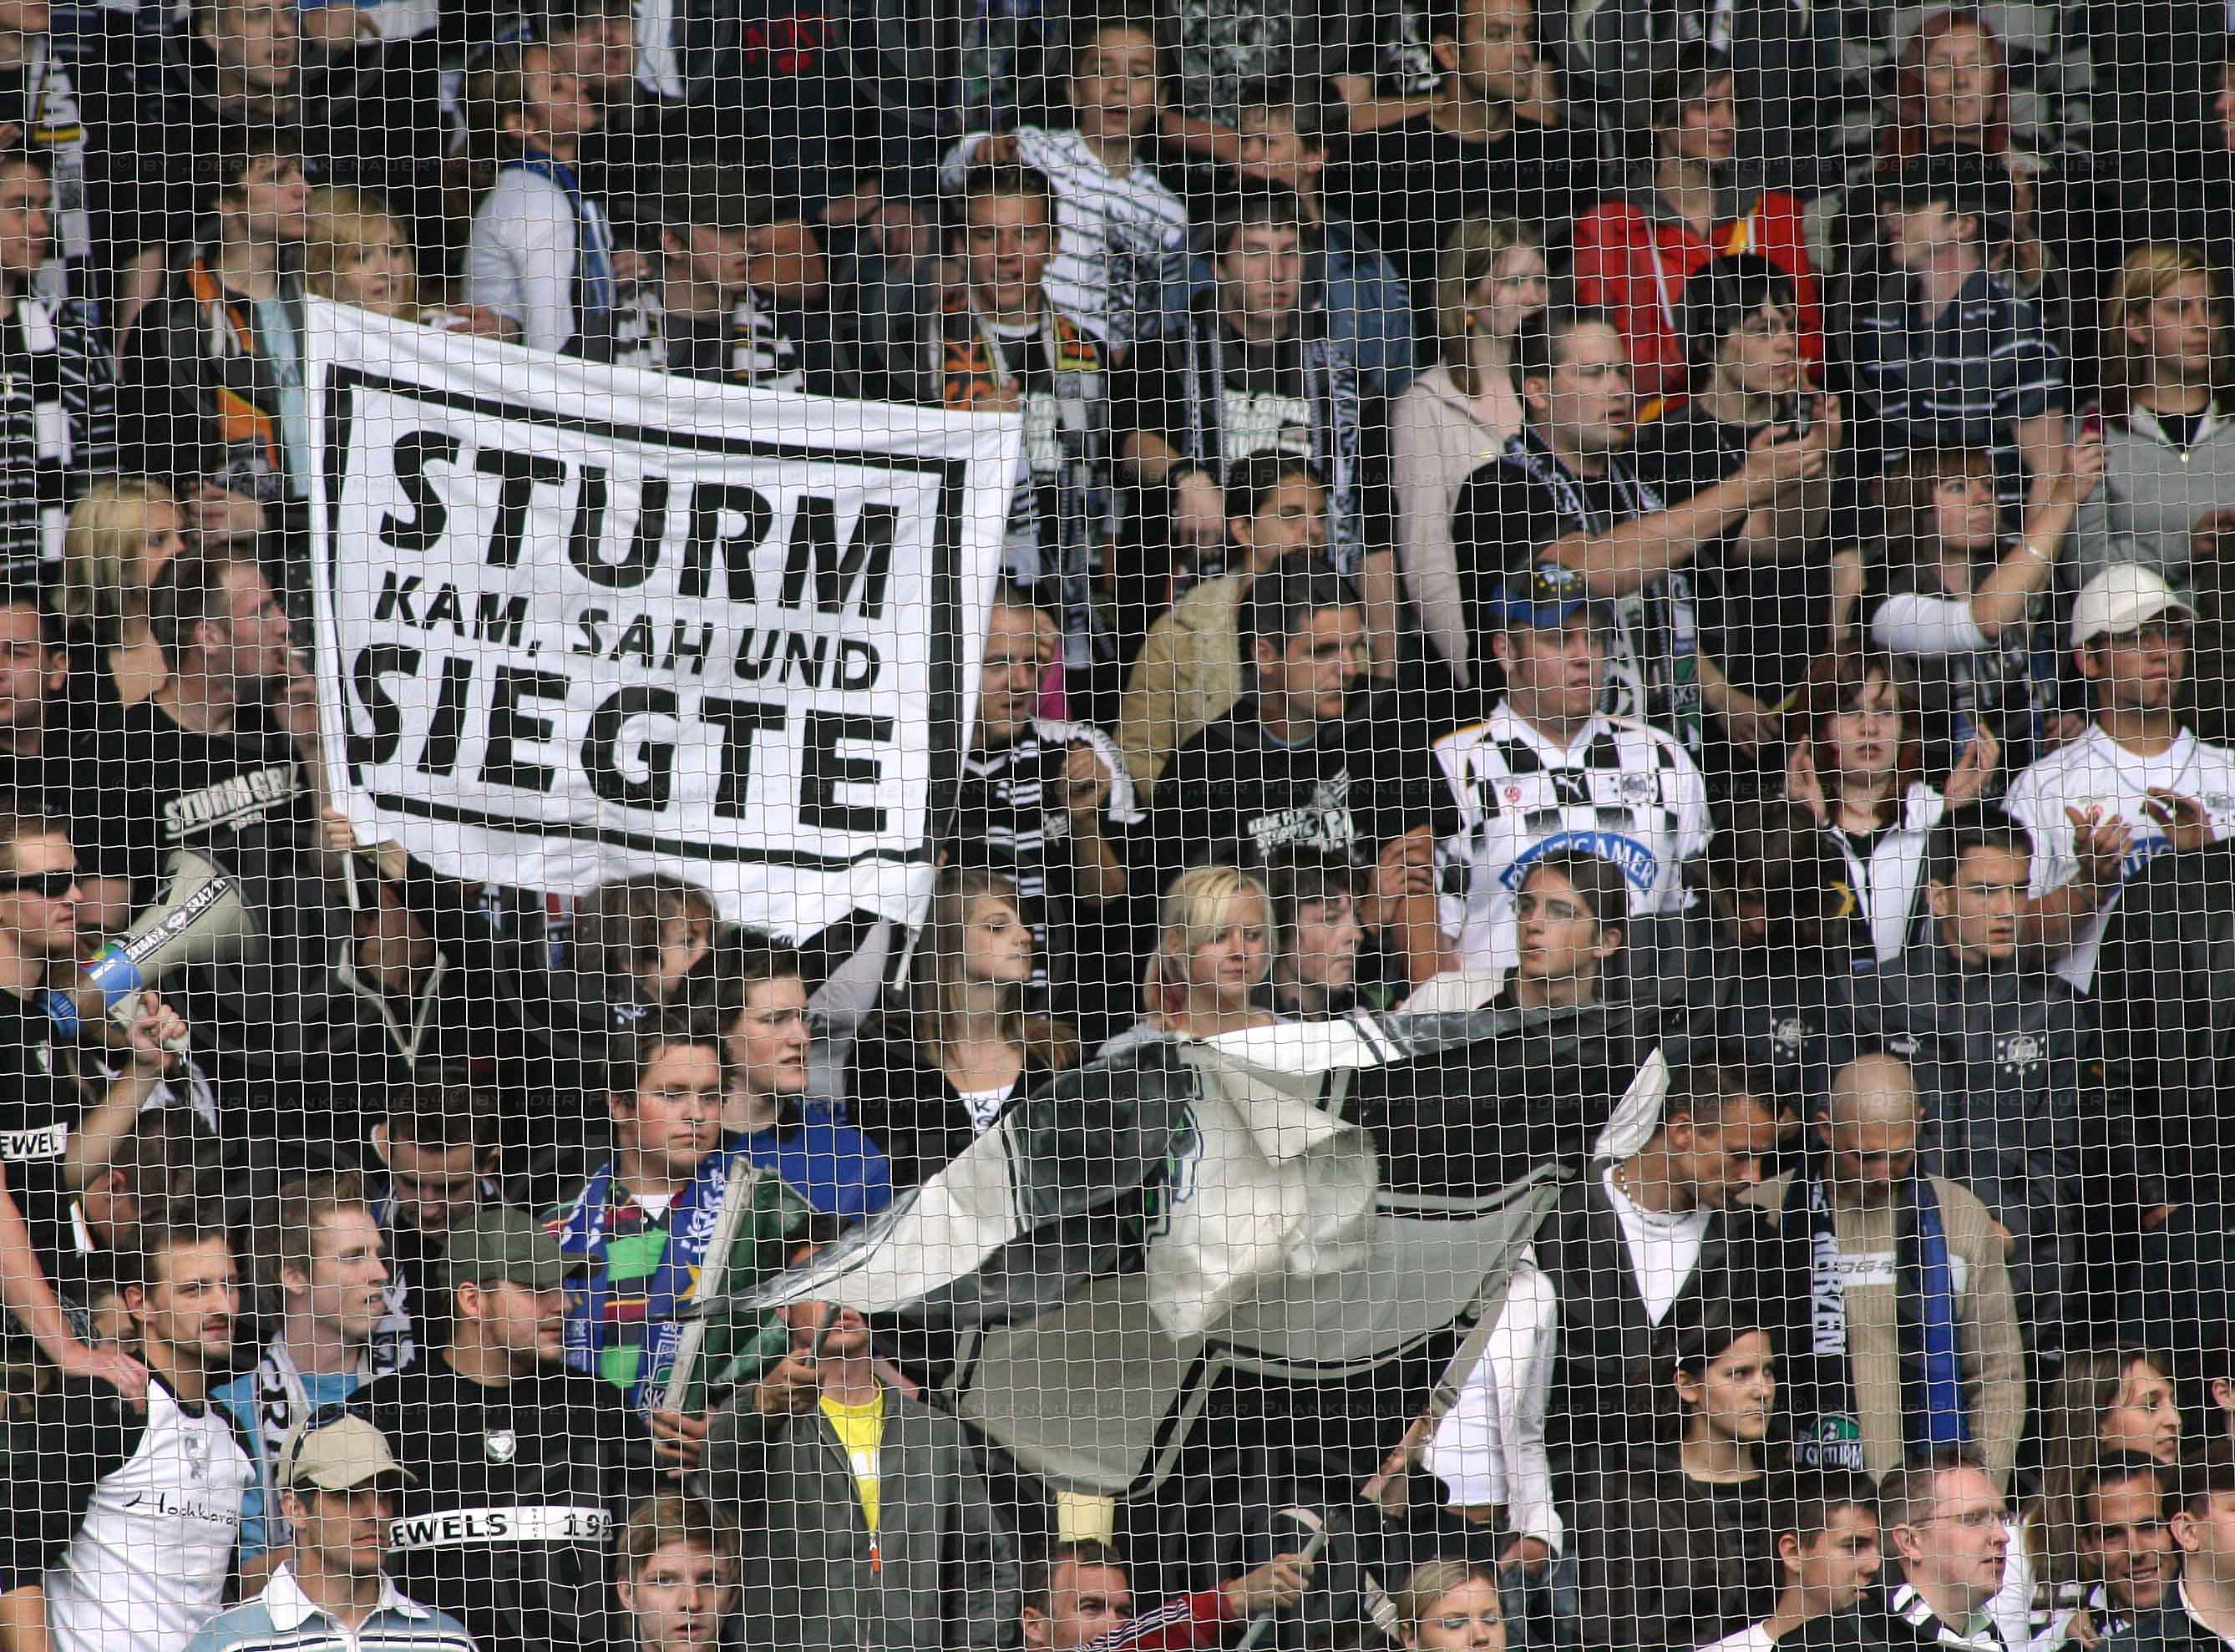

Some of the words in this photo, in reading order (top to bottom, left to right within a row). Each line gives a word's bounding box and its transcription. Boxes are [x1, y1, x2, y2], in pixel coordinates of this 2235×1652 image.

[379, 430, 900, 620] STURM
[375, 570, 541, 657] KAM,
[572, 607, 713, 675] SAH
[732, 626, 881, 692] UND
[346, 642, 894, 831] SIEGTE
